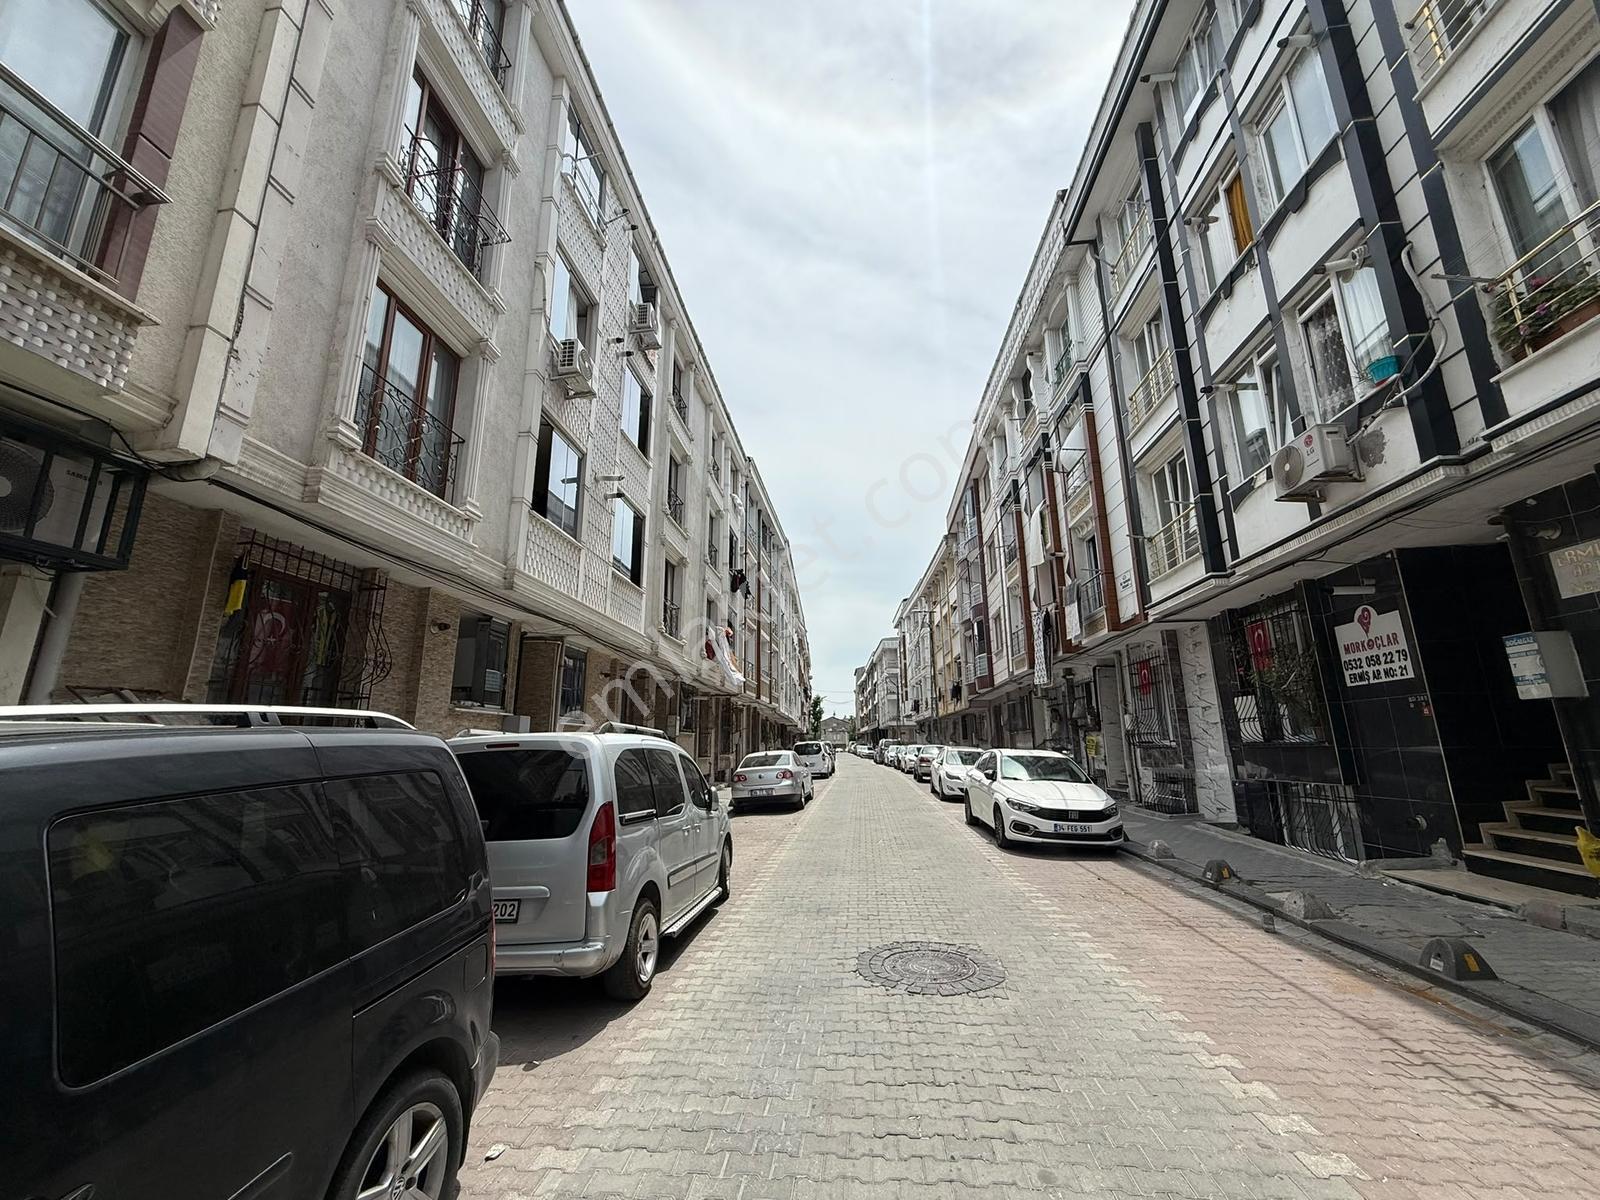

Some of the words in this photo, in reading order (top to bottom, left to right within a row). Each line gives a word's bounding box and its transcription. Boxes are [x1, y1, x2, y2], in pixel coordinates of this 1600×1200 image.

[1306, 446, 1315, 456] LG
[1343, 632, 1400, 655] MORKOÇLAR
[1343, 657, 1363, 671] 0532
[1365, 654, 1382, 667] 058
[1382, 651, 1395, 665] 22
[1395, 648, 1408, 662] 79
[1383, 666, 1397, 679] NO:
[1398, 664, 1409, 676] 21
[494, 903, 516, 917] 202
